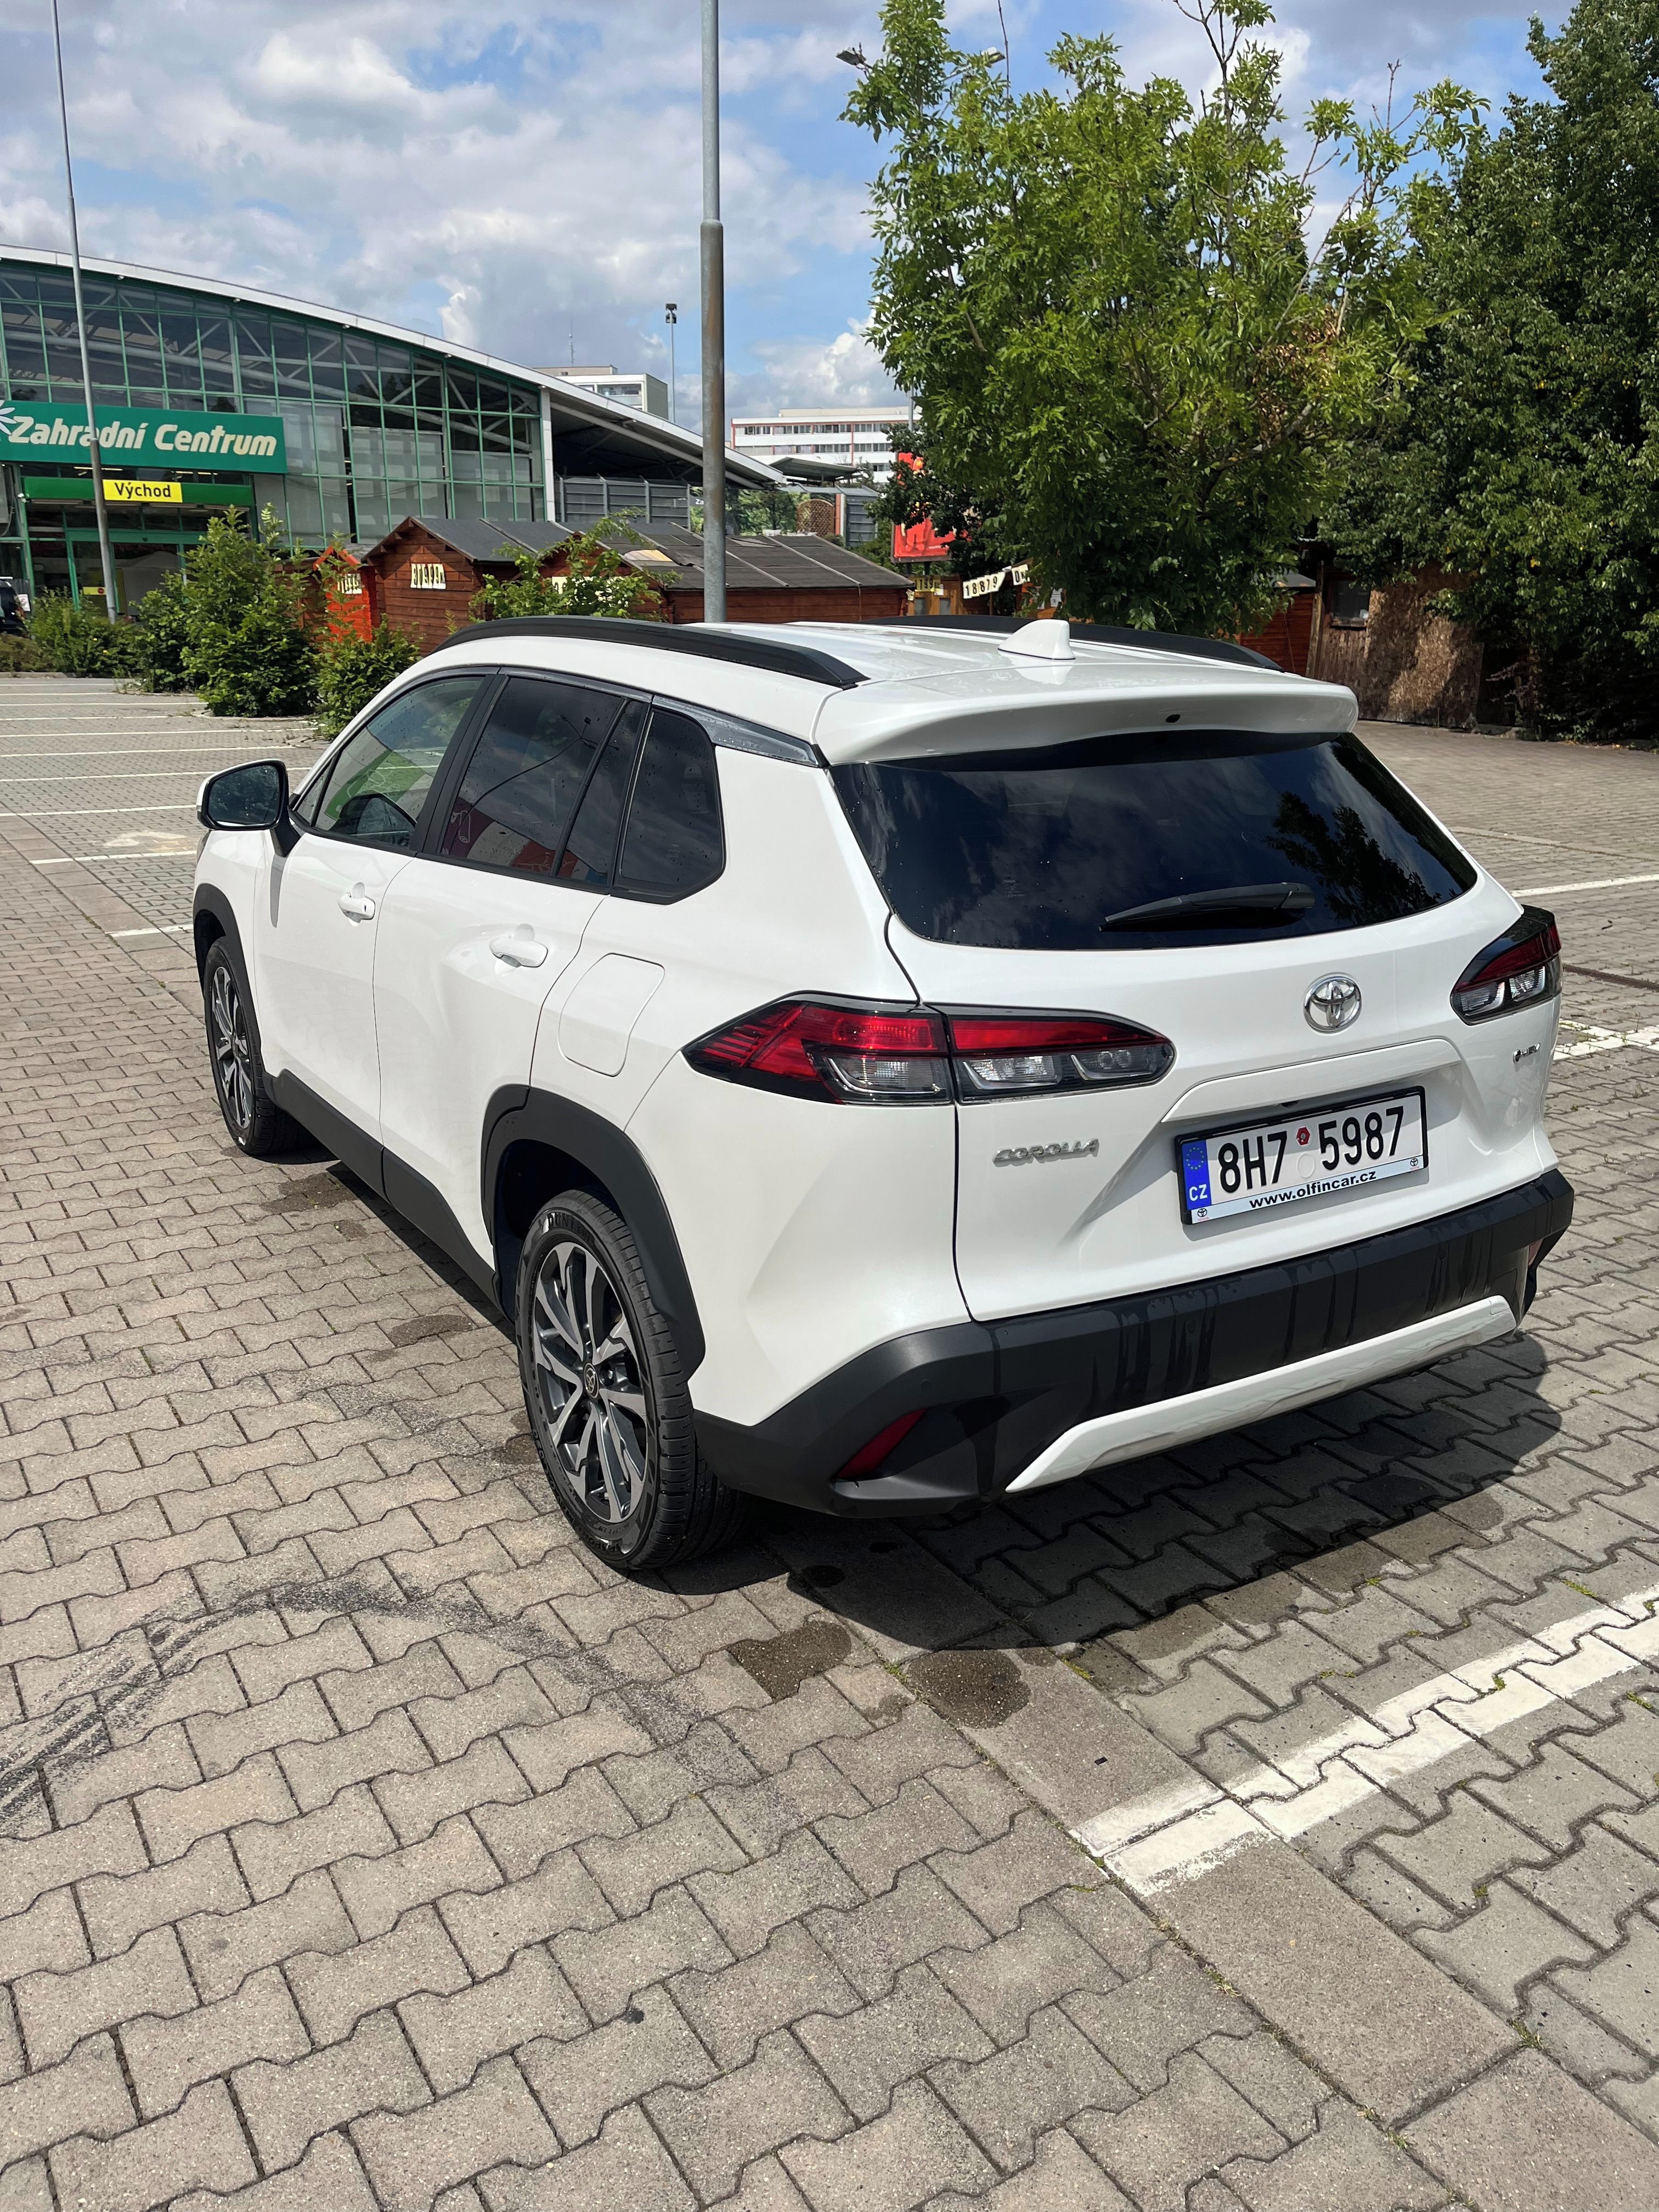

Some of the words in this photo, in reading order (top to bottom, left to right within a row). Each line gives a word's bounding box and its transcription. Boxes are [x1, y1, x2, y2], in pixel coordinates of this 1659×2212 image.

[8, 415, 149, 449] Zahradní
[155, 424, 277, 456] Centrum
[114, 482, 171, 499] Východ
[992, 1138, 1099, 1165] COROLLA
[1217, 1131, 1288, 1194] 8H7
[1318, 1105, 1404, 1171] 5987
[1189, 1184, 1207, 1201] CZ
[1249, 1170, 1377, 1209] www.olfincar.cz
